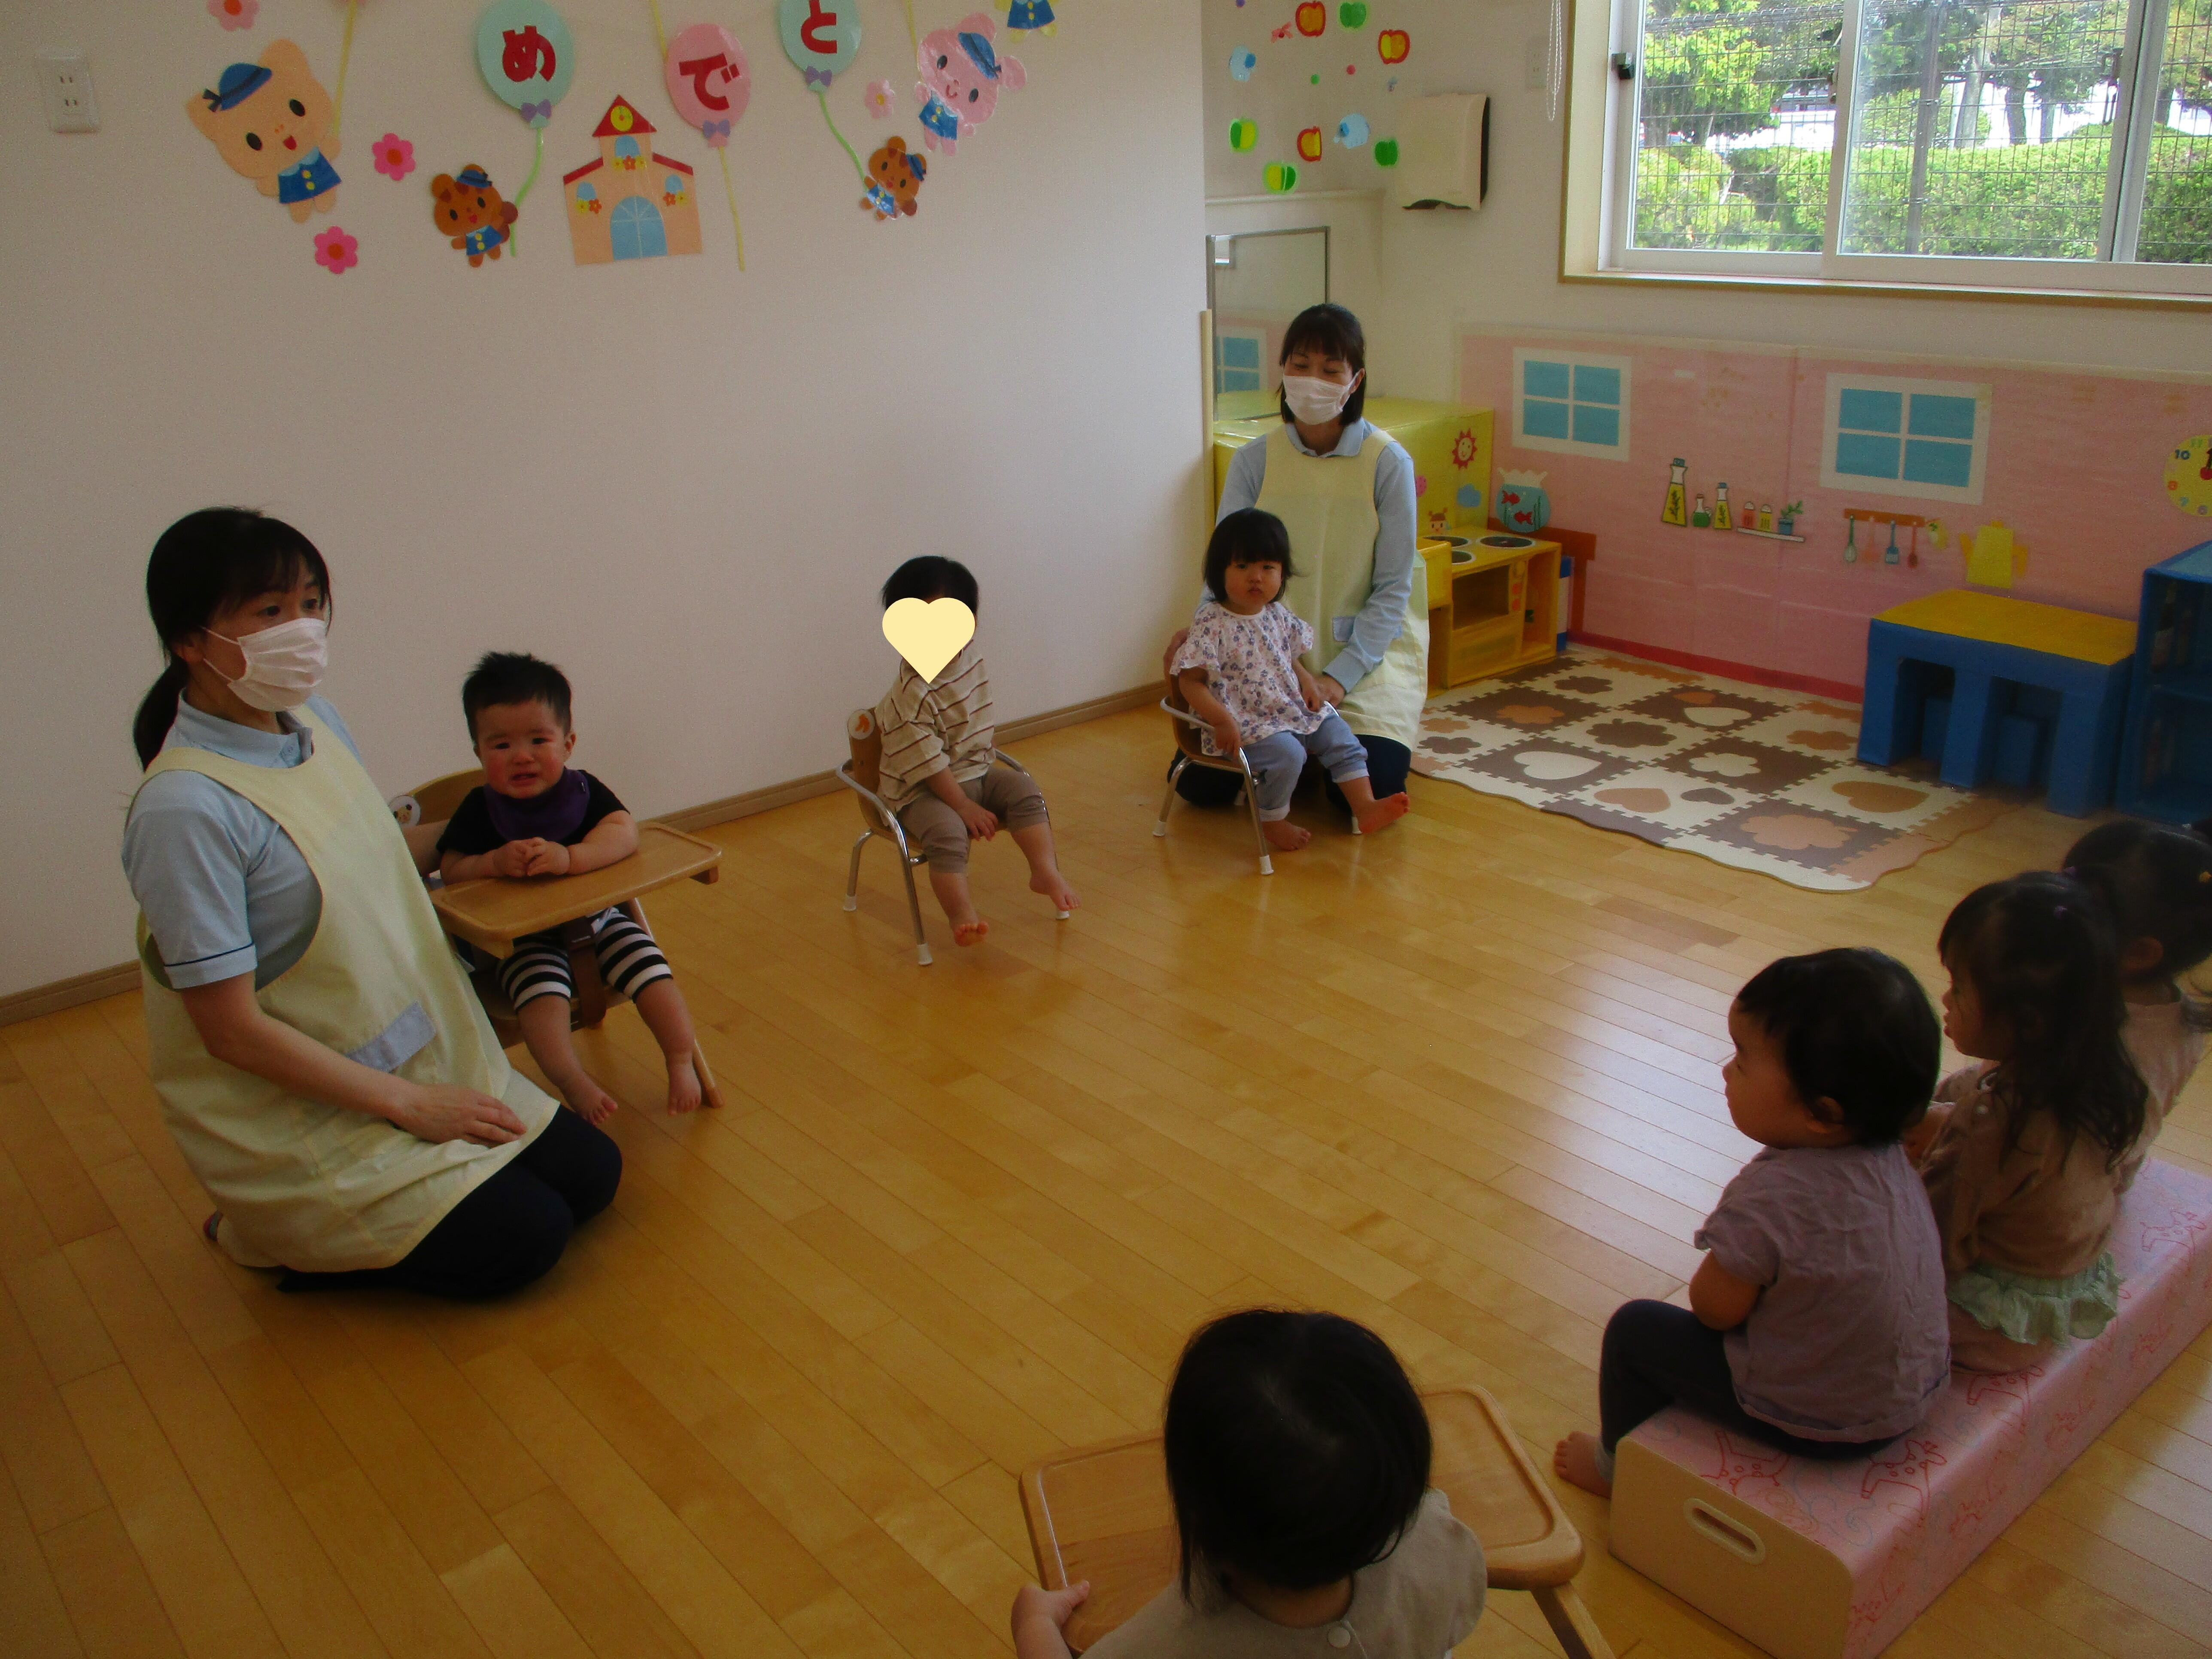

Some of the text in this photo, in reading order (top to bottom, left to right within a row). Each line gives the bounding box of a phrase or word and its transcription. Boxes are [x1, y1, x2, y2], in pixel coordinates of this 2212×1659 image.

[801, 0, 837, 53] と
[502, 26, 556, 82] め
[679, 54, 740, 110] で
[2175, 450, 2191, 460] 10
